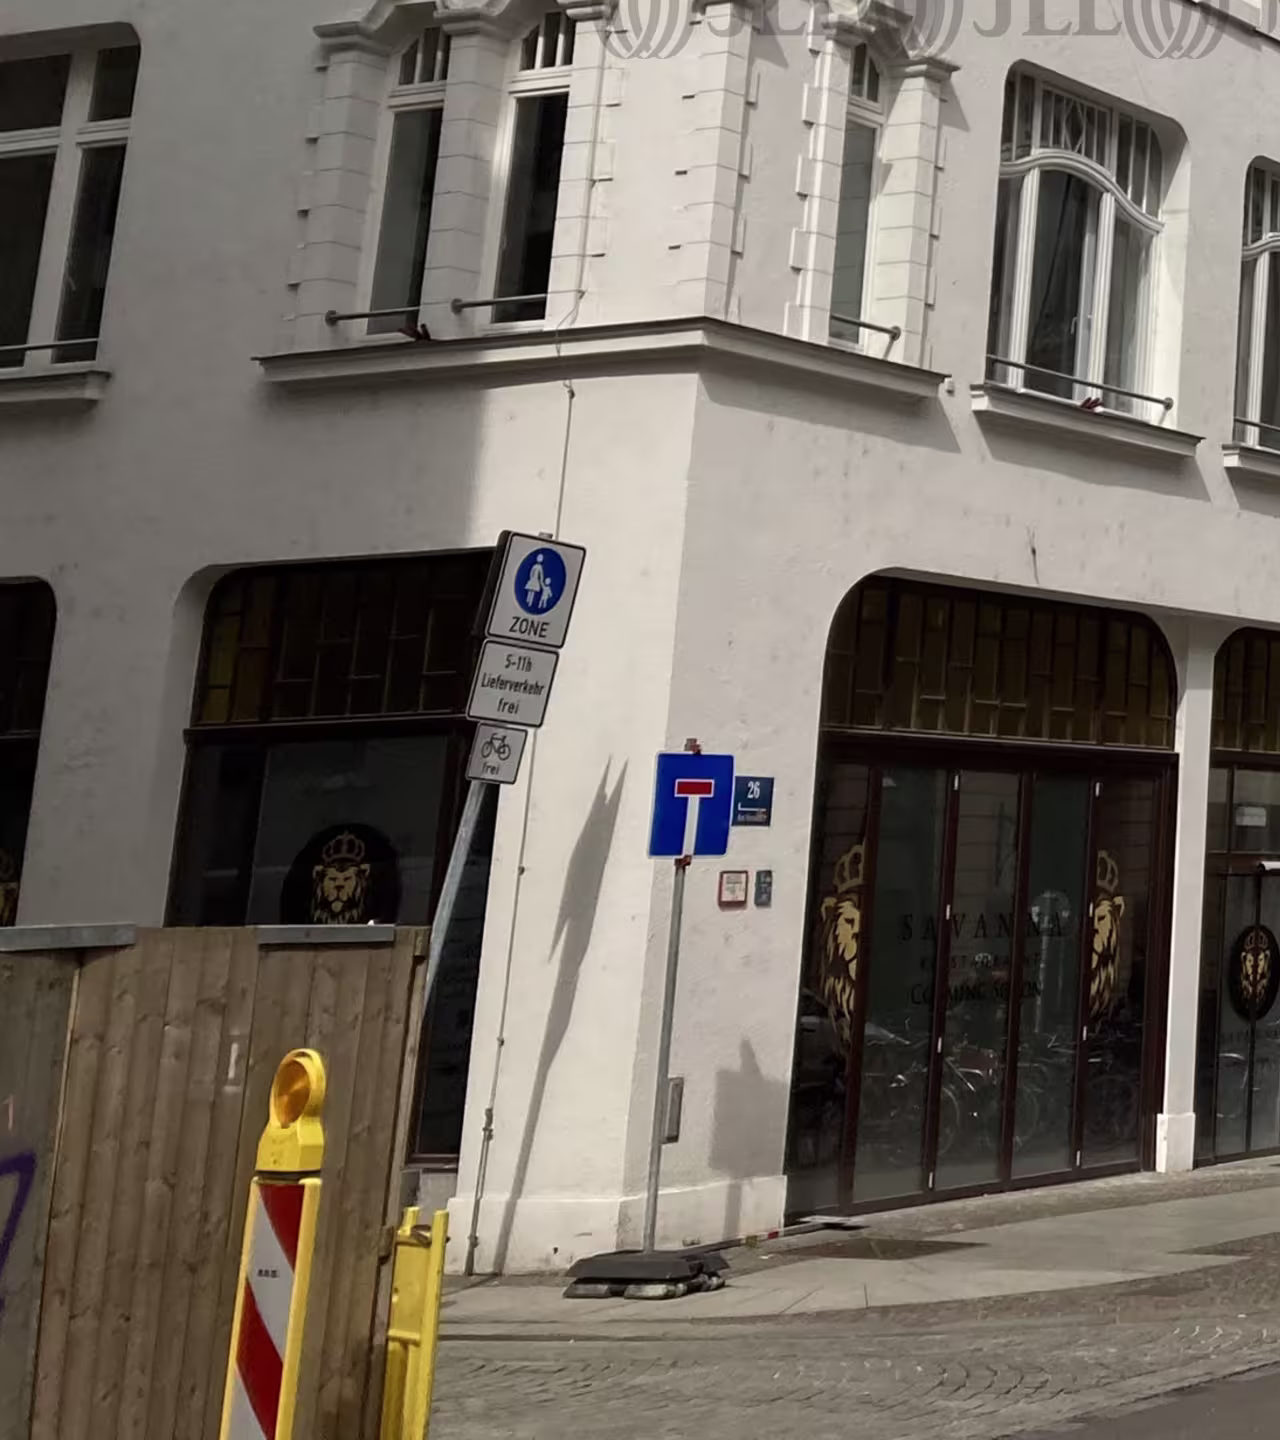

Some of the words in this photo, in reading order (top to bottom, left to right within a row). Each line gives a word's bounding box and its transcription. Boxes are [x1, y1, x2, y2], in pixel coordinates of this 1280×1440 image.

[509, 616, 550, 638] ZONE
[481, 673, 545, 696] Lieferverkehr
[497, 697, 520, 715] frei
[482, 761, 500, 775] frei
[747, 781, 760, 799] 26
